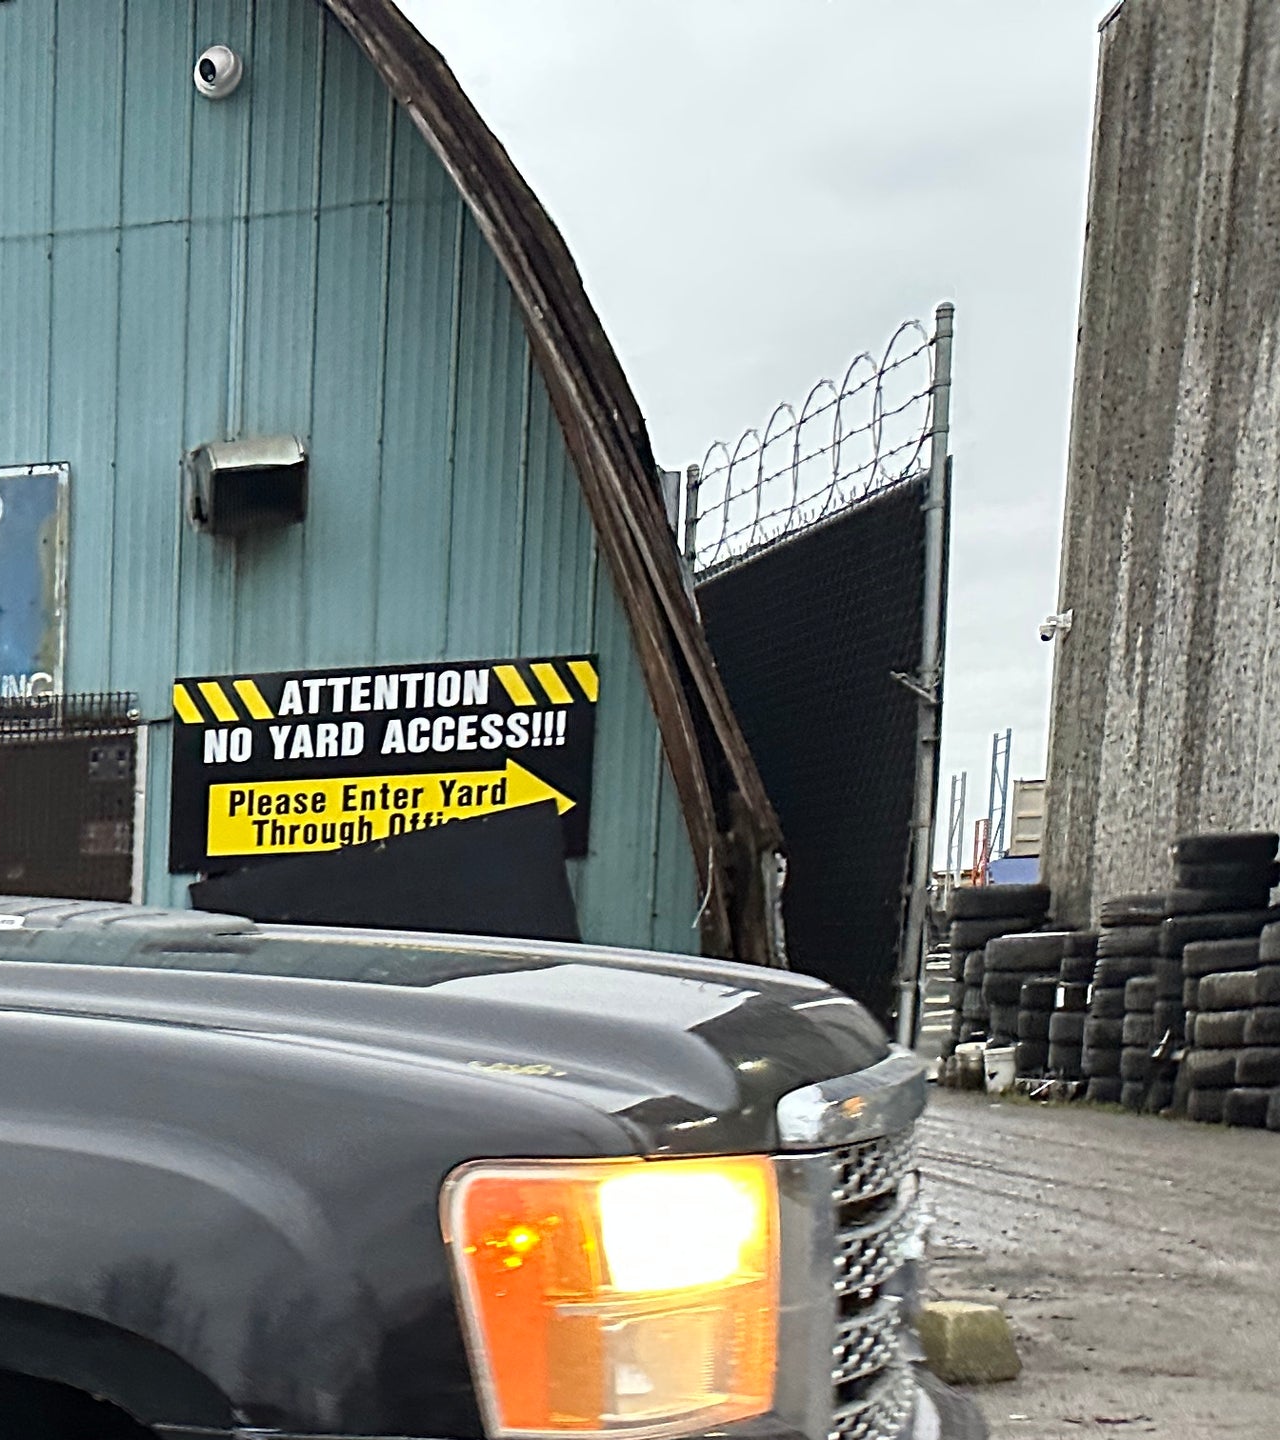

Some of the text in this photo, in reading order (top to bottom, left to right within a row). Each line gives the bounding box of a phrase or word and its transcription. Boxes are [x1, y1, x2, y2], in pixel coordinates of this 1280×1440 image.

[277, 668, 490, 717] ATTENTION
[202, 710, 567, 764] NO YARD ACCESS!!!
[228, 777, 507, 818] Please Enter Yard
[251, 815, 373, 848] Through
